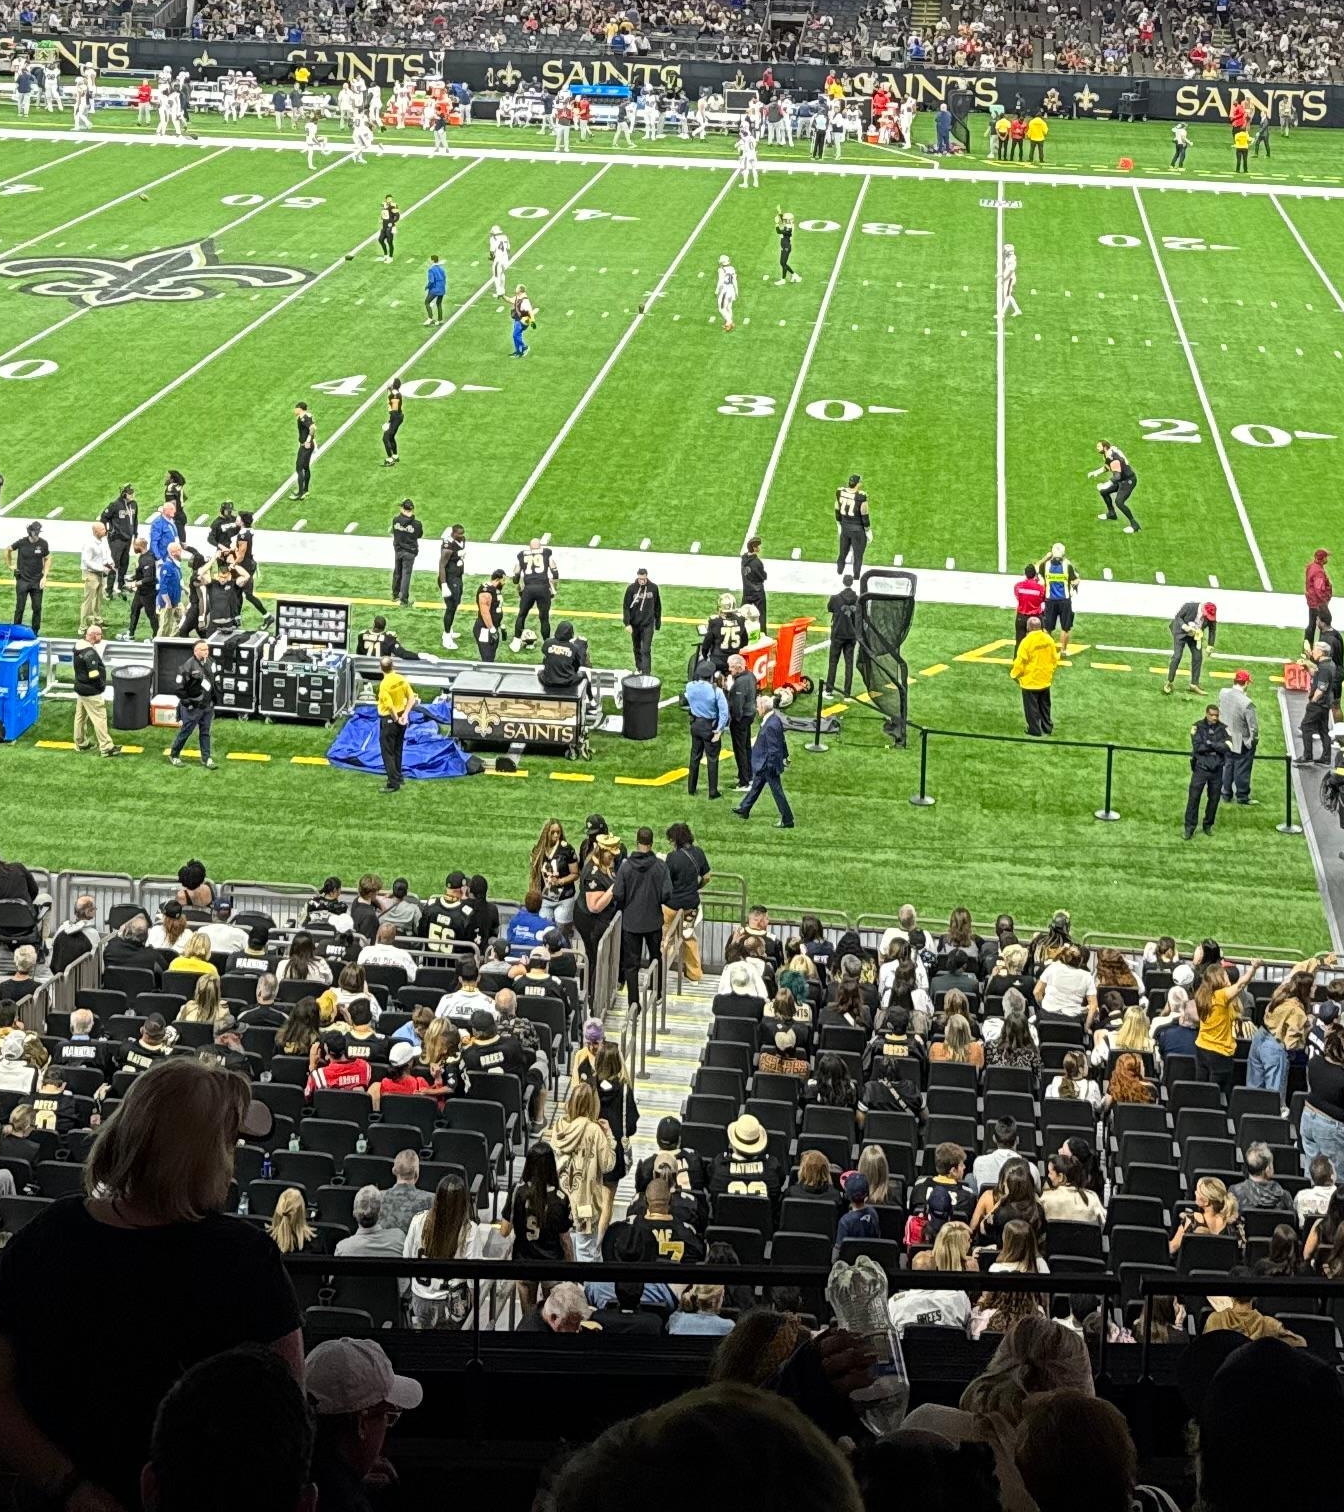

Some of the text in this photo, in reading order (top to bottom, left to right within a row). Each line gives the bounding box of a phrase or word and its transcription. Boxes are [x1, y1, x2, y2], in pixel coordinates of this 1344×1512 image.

[1175, 84, 1327, 121] SAINTS
[310, 374, 457, 400] 40
[716, 394, 864, 423] 30
[1138, 418, 1292, 448] 20
[523, 555, 544, 574] 79
[720, 626, 742, 649] 75
[503, 722, 574, 743] SAINTS
